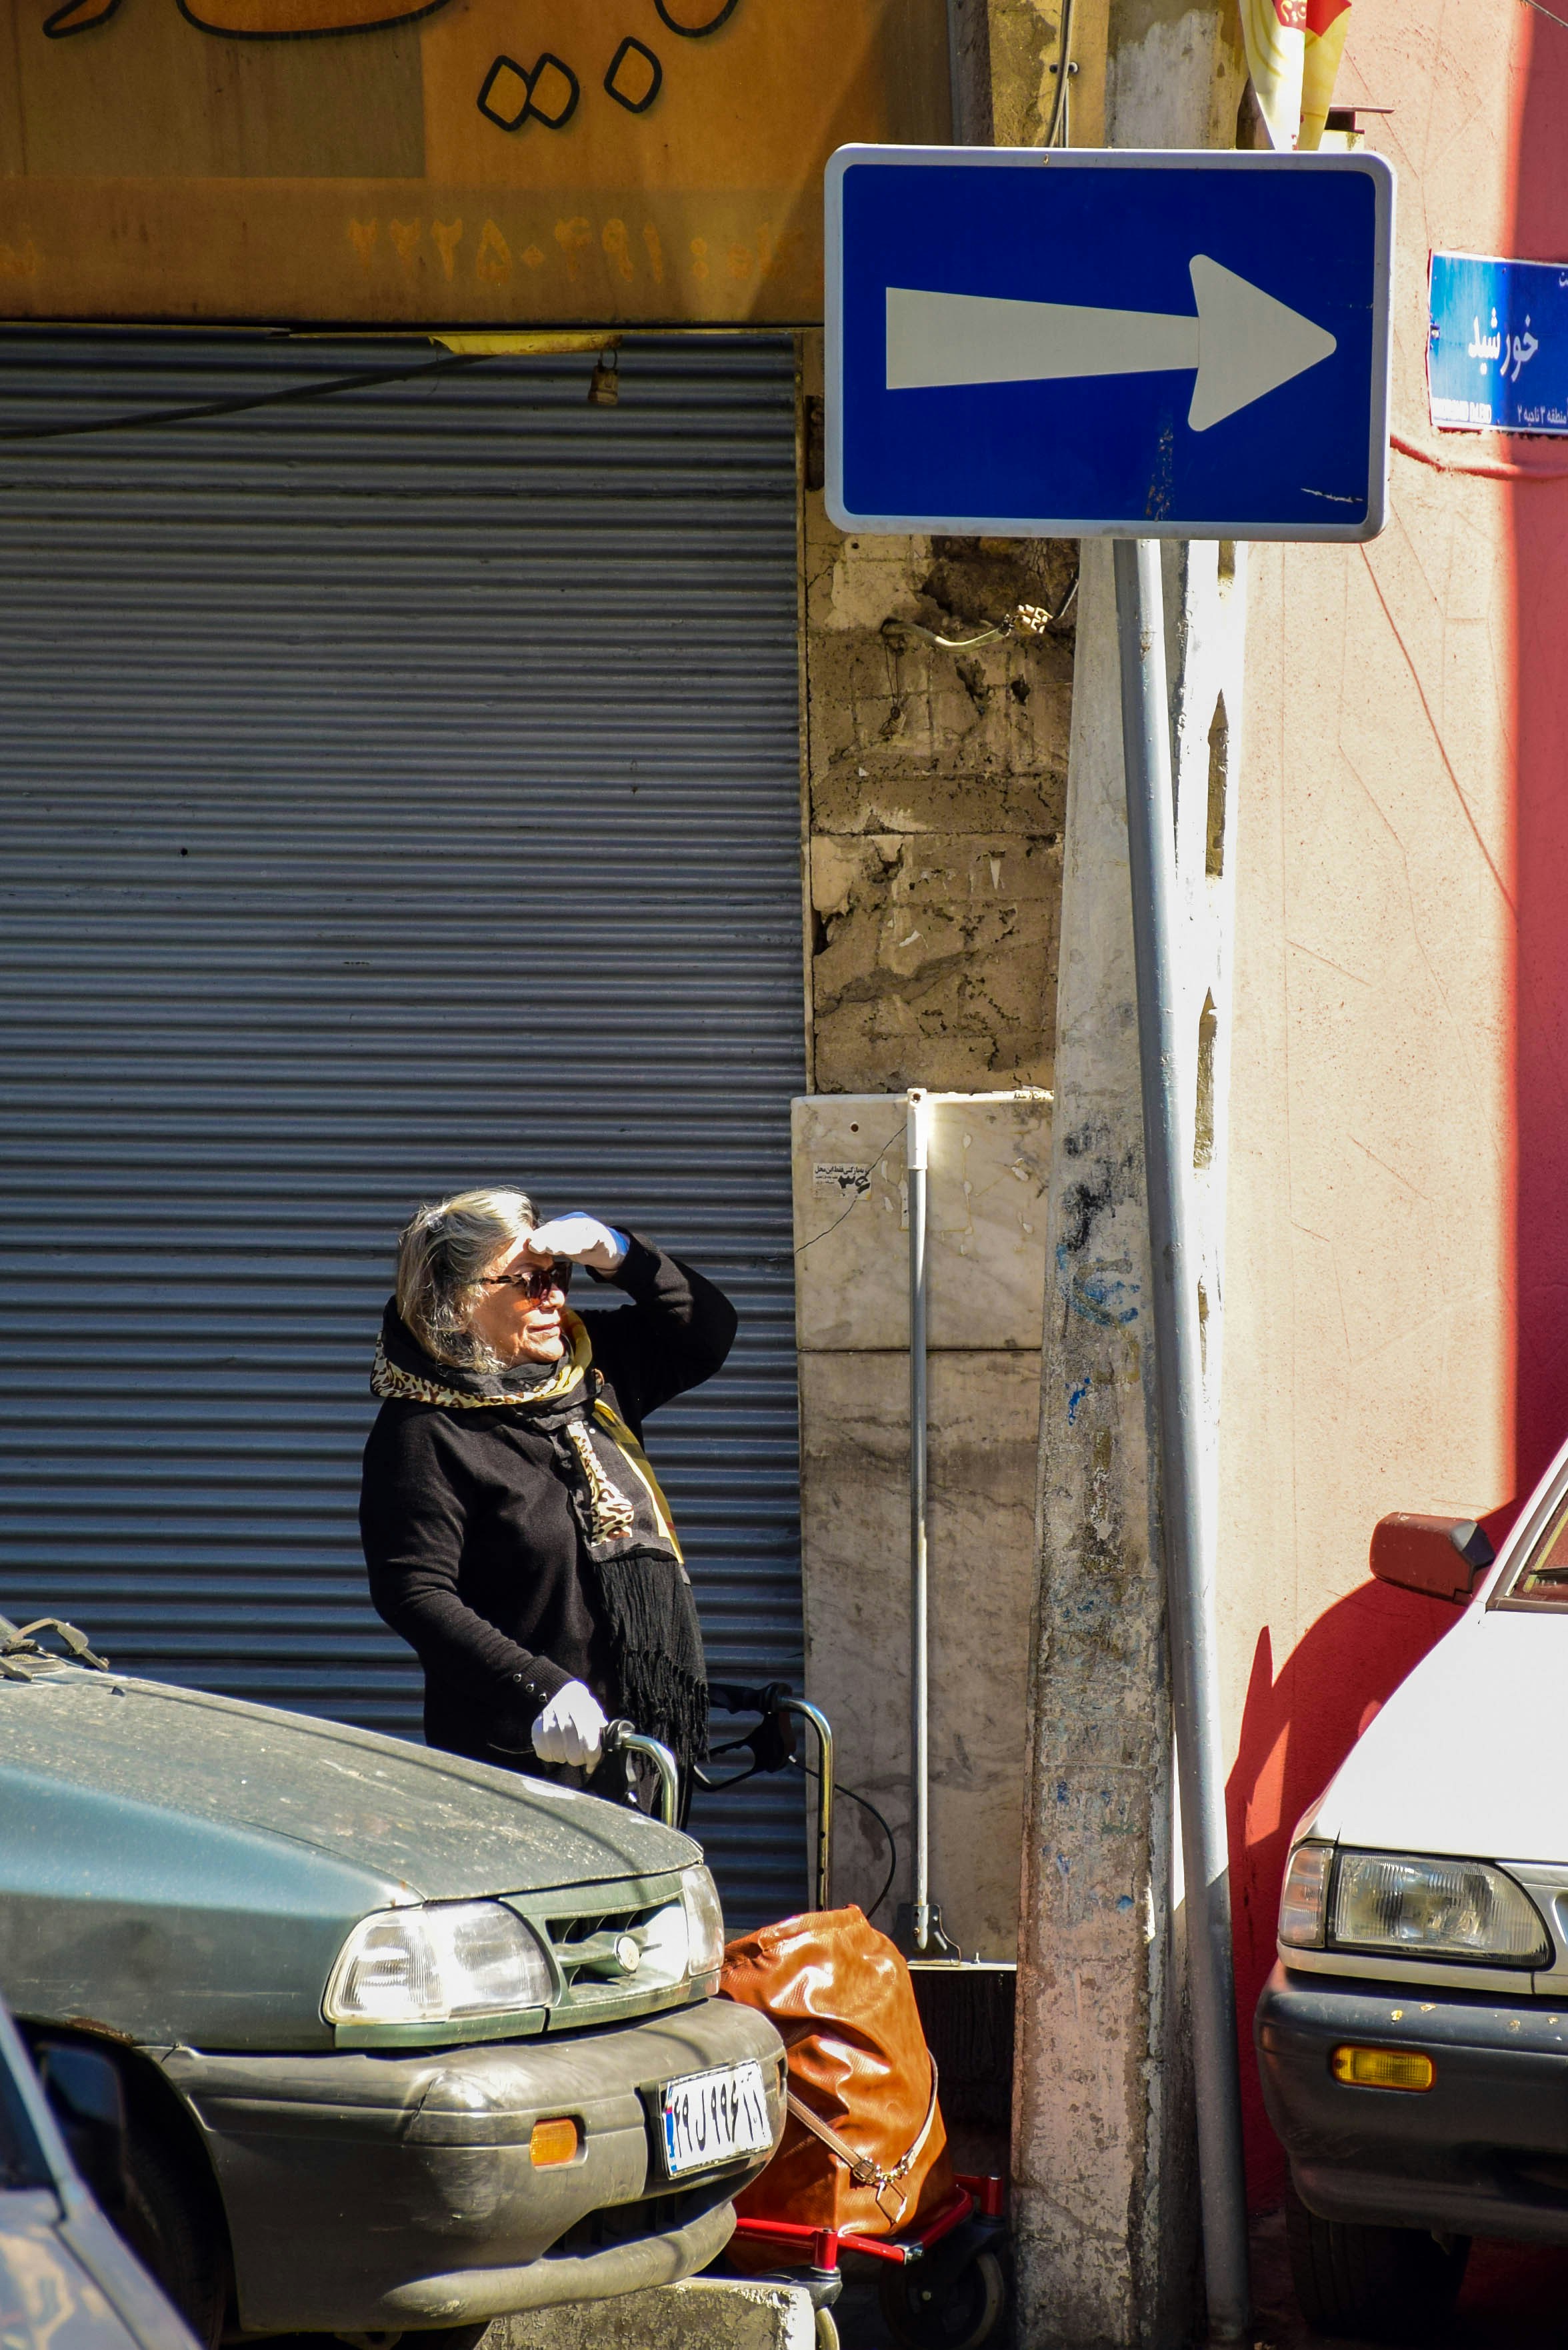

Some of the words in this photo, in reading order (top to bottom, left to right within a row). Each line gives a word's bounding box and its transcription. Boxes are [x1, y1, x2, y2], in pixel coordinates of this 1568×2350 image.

[1468, 307, 1539, 382] خورشید
[1523, 406, 1540, 427] ناحیه
[1547, 407, 1567, 425] منطقه
